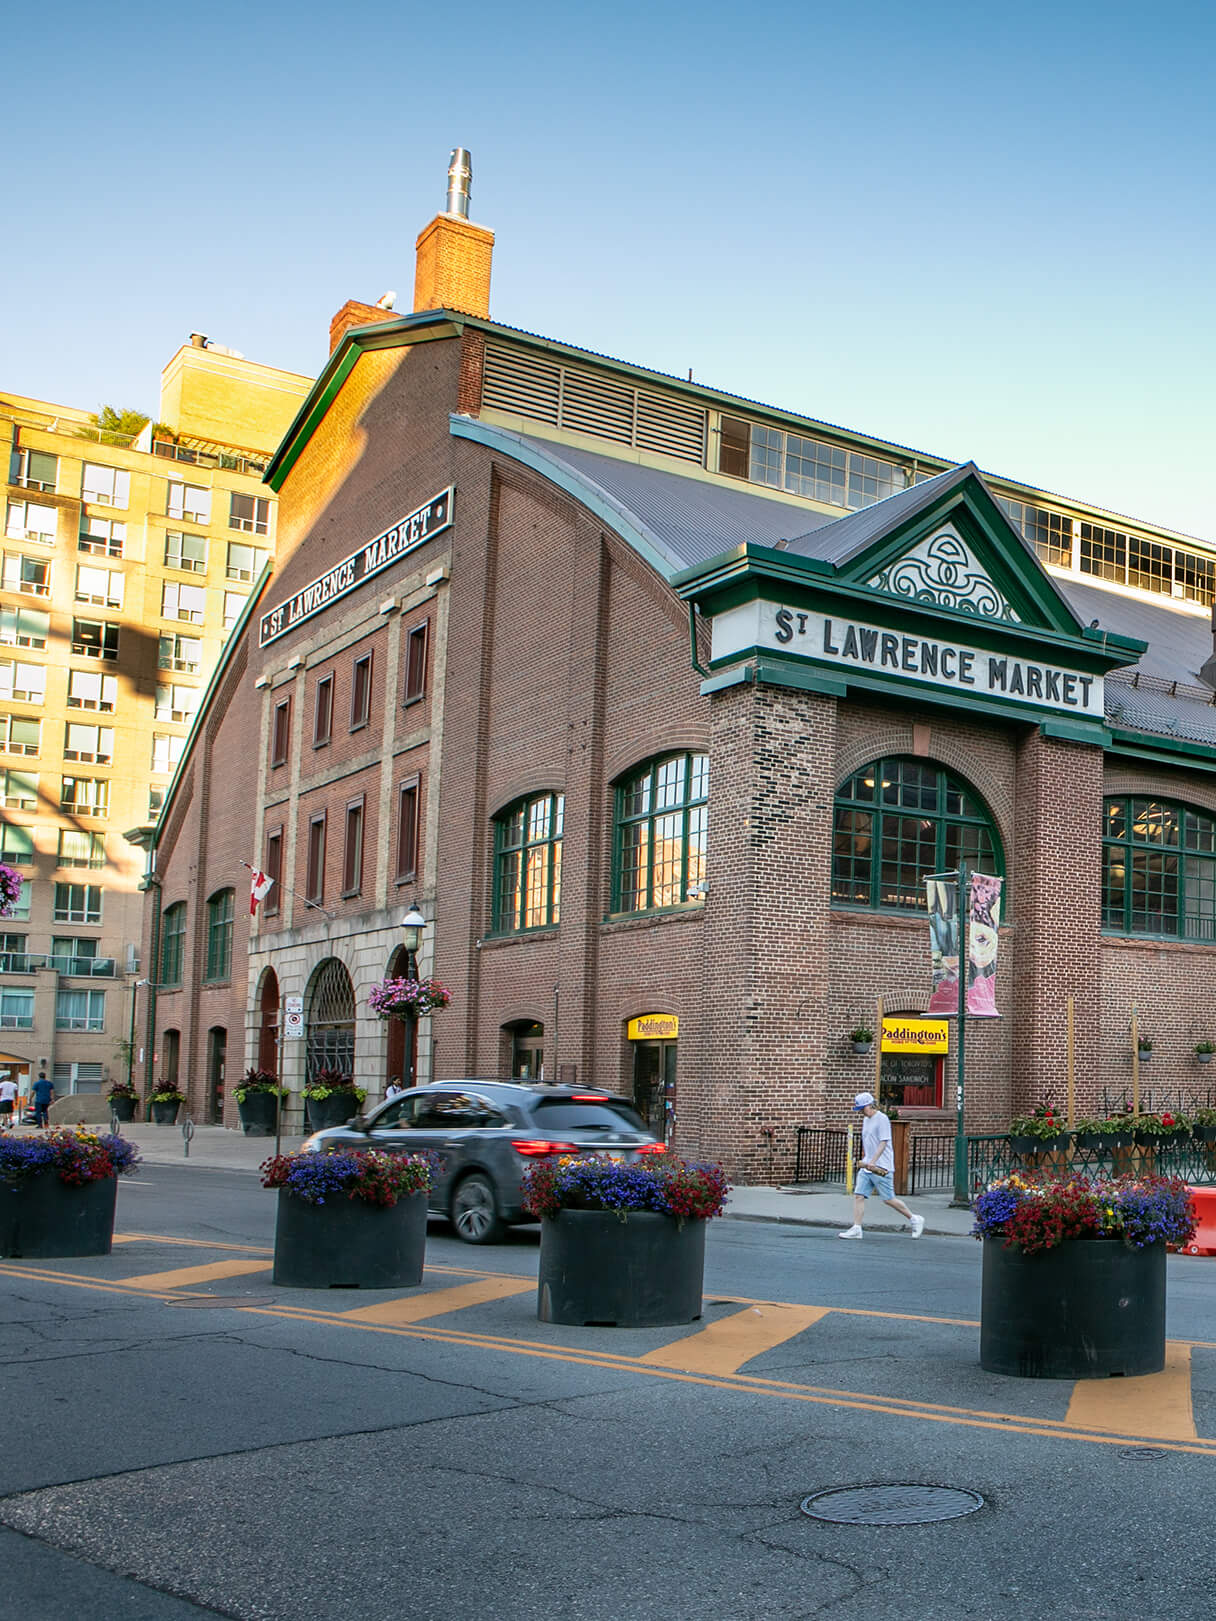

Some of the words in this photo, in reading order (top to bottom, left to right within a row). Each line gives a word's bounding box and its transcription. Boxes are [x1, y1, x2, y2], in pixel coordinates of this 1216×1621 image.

[270, 607, 284, 636] ST
[288, 558, 356, 624] LAWRENCE
[363, 506, 432, 574] MARKET
[823, 619, 976, 685] LAWRENCE
[988, 657, 1094, 708] MARKET
[881, 1027, 946, 1045] Paddington's
